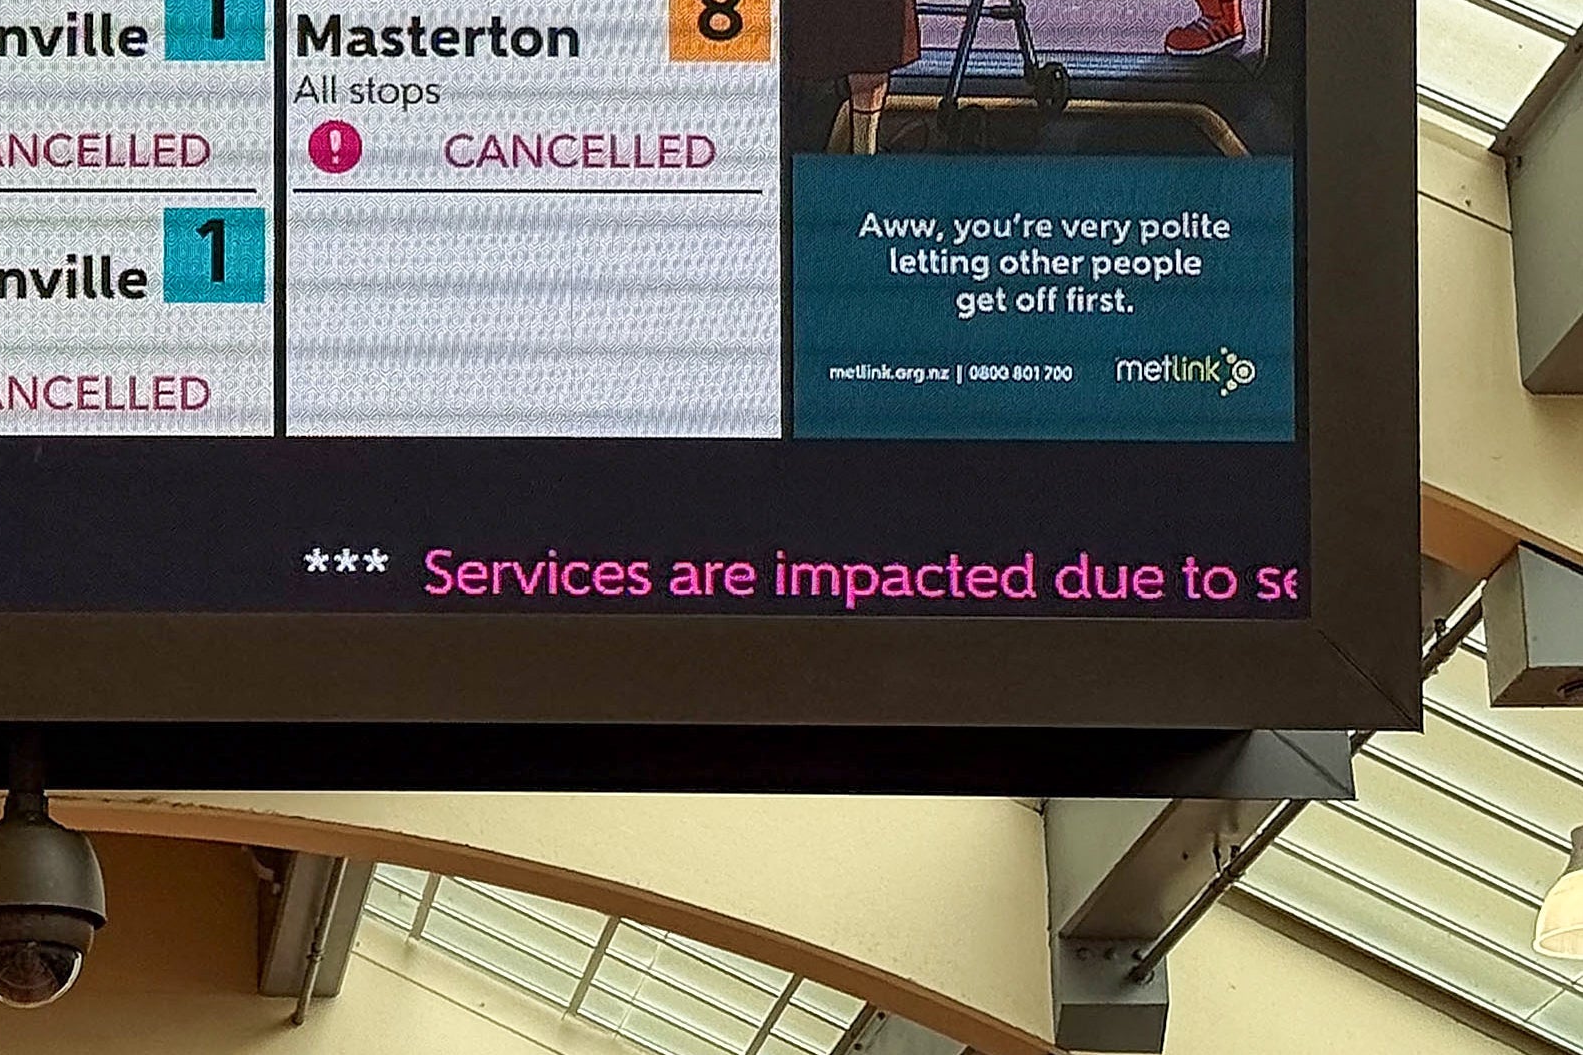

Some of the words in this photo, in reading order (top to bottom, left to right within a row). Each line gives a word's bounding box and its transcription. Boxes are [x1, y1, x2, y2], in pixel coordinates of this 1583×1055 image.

[298, 14, 579, 57] Masterton
[294, 75, 336, 103] All
[350, 78, 440, 111] stops
[445, 134, 716, 168] CANCELLED
[860, 213, 943, 241] Aww,
[954, 213, 1052, 244] you're
[1062, 220, 1130, 244] very
[1140, 213, 1229, 244] polite
[197, 219, 224, 282] 1
[891, 248, 989, 280] letting
[1000, 249, 1084, 274] other
[1092, 249, 1201, 280] people
[957, 288, 1006, 318] get
[1016, 287, 1057, 311] off
[1067, 287, 1133, 312] first.
[830, 364, 949, 383] metlink.org.nz
[969, 366, 1009, 380] 0800
[1013, 366, 1039, 380] 801
[1045, 366, 1072, 381] 700
[1117, 355, 1219, 381] metlink
[425, 549, 652, 596] Services
[670, 560, 757, 596] are
[775, 550, 1038, 609] impacted
[1055, 553, 1165, 600] due
[1182, 556, 1238, 600] to
